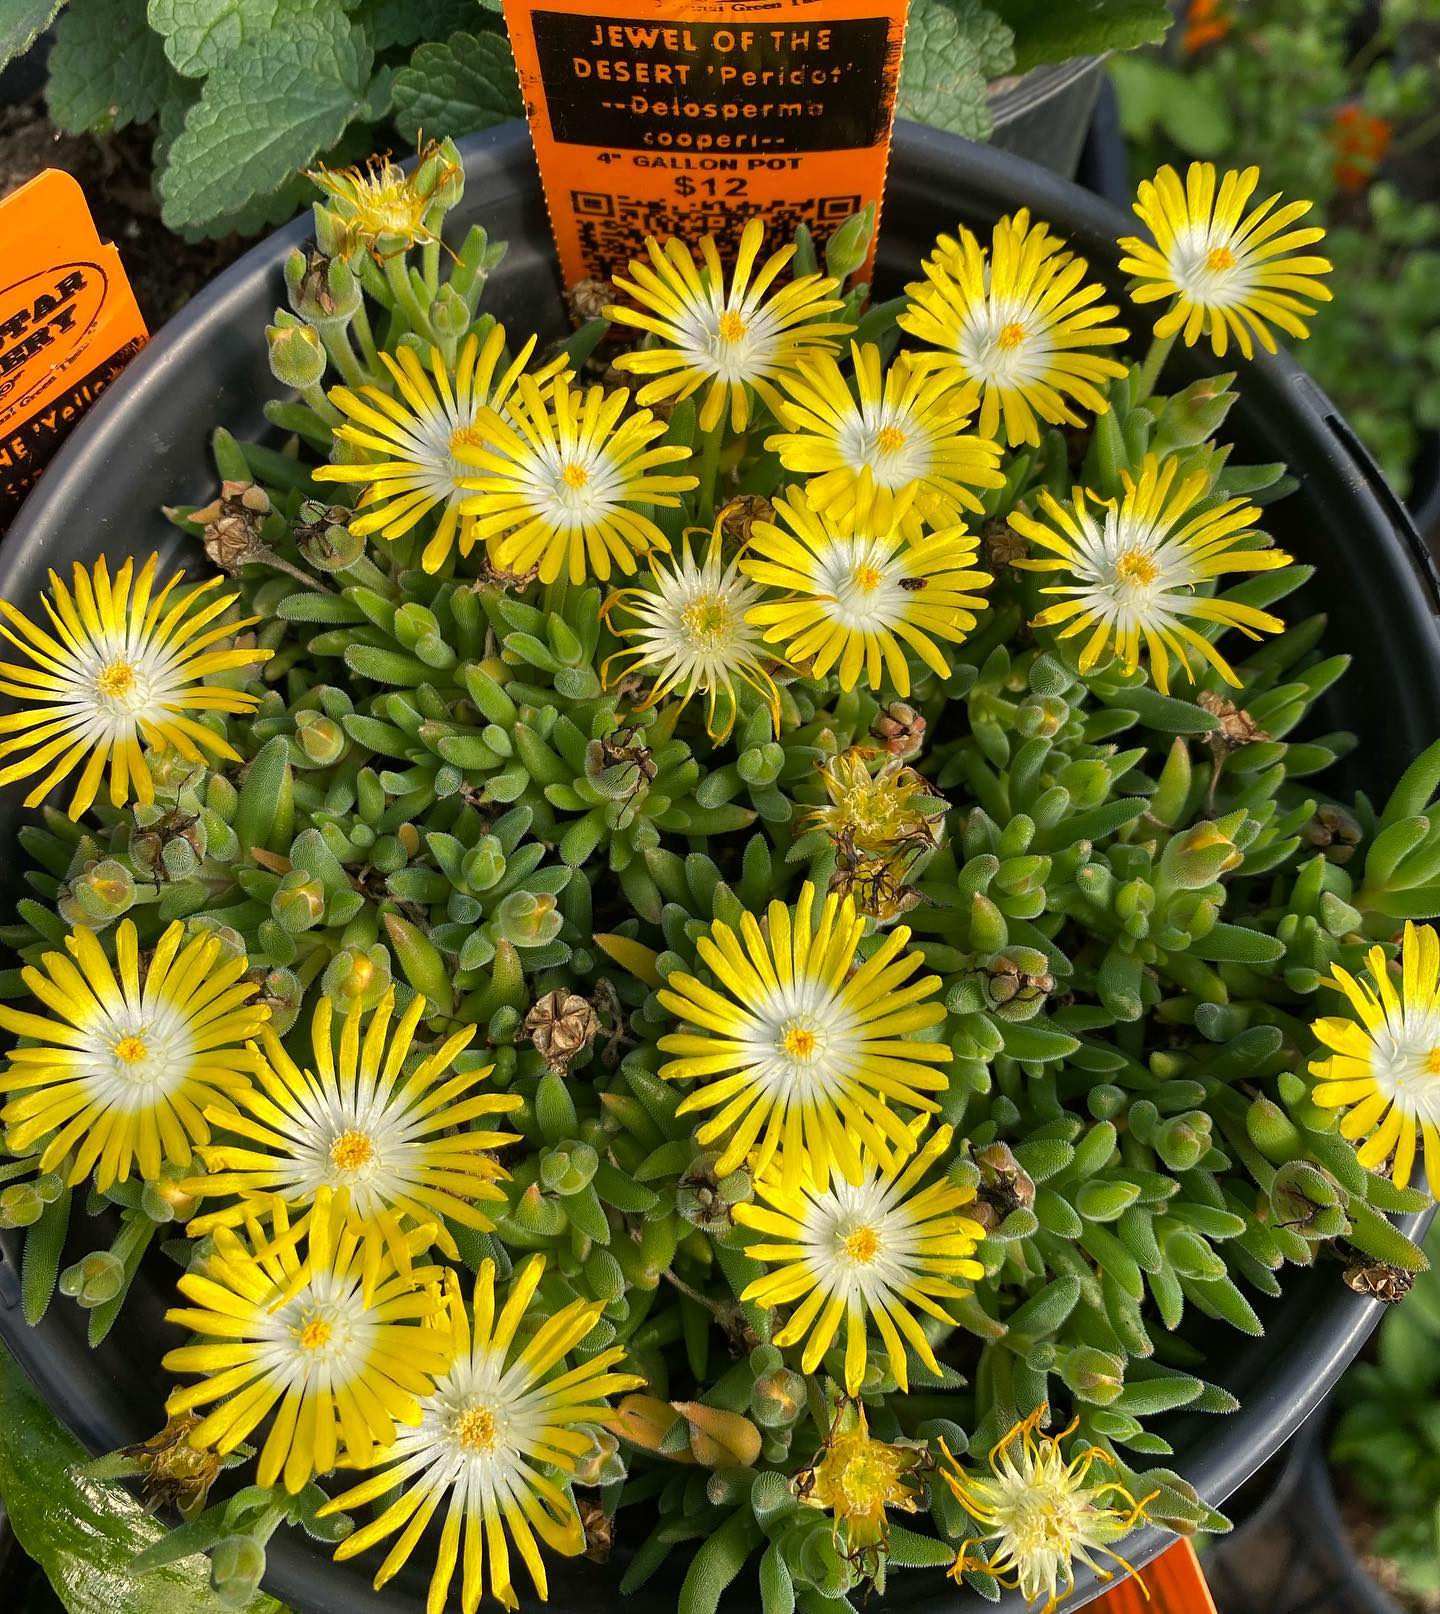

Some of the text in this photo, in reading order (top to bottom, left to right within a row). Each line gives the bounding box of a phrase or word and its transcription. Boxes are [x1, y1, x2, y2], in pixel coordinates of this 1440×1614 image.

[591, 24, 832, 53] JEWEL OF THE
[572, 57, 691, 86] DESERT
[632, 154, 738, 171] GALLON
[746, 156, 803, 171] POT
[673, 174, 749, 198] $12
[0, 270, 88, 350] TAR
